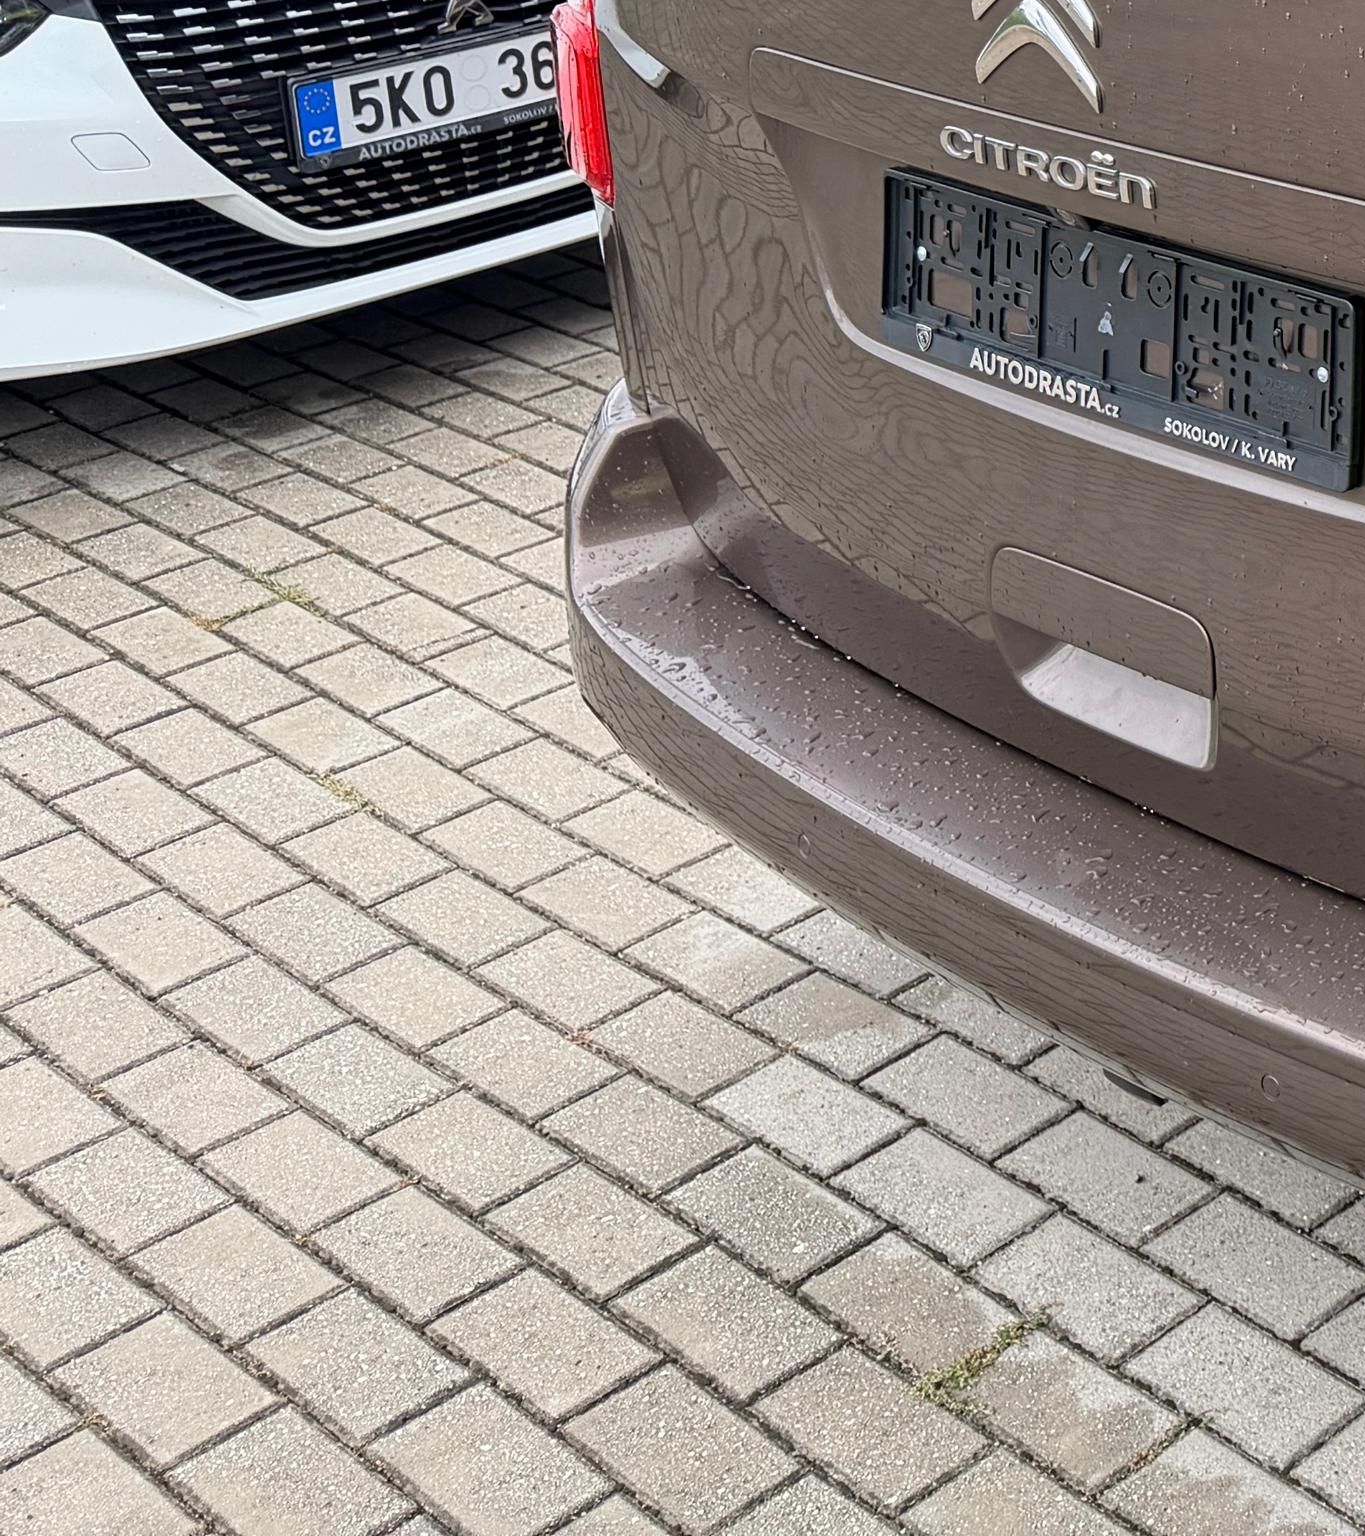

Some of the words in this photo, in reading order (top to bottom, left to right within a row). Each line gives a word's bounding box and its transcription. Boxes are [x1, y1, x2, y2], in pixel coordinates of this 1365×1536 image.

[503, 105, 547, 125] SOKOLOV
[308, 126, 336, 147] CZ
[1164, 417, 1228, 451] SOKOLOV
[1231, 439, 1239, 454] /
[1241, 441, 1255, 459] K.
[1258, 447, 1296, 471] VARY
